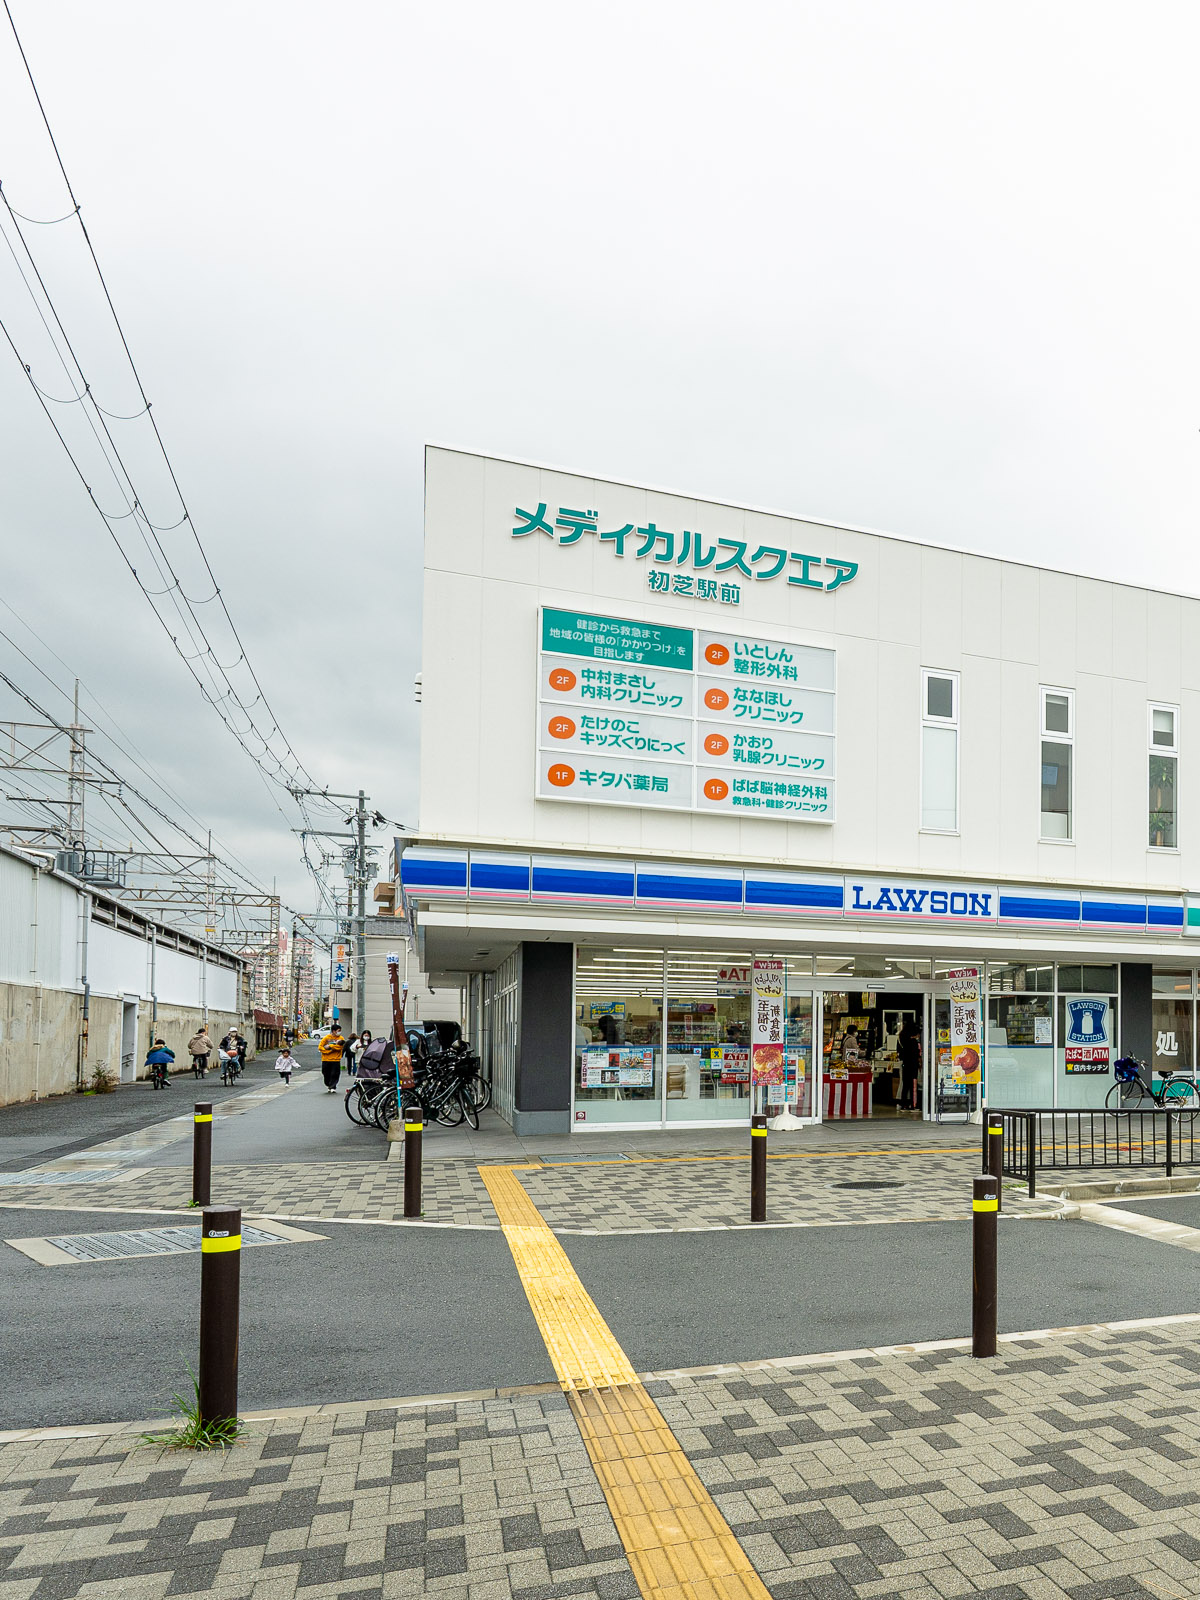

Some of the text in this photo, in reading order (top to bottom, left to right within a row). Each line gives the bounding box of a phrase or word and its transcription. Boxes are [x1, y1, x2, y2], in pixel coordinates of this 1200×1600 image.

[512, 502, 859, 592] メディカルスクエア
[648, 569, 742, 604] 初芝駅前
[576, 618, 661, 638] 健診から救急まで
[549, 628, 686, 656] 地域の皆様の「かかりつけ」を
[594, 646, 644, 662] 目指します
[710, 650, 724, 659] 2F
[734, 641, 793, 663] いとしん
[581, 668, 656, 690] 中村まさし
[734, 659, 798, 681] 整形外科
[556, 675, 570, 685] 2F
[581, 685, 683, 708] 内科クリニック
[710, 695, 723, 704] 2F
[733, 687, 792, 707] ななほし
[733, 704, 804, 724] クリニック
[555, 723, 569, 733] 2F
[580, 715, 640, 734] たけのこ
[580, 731, 686, 755] キッズくりにっく
[710, 740, 723, 749] 2F
[733, 734, 773, 750] かおり
[732, 748, 825, 770] 乳腺クリニック
[555, 771, 568, 780] 1F
[579, 769, 669, 792] キタバ薬局
[710, 785, 722, 794] 1F
[732, 778, 828, 800] ばば脳神経外科
[732, 795, 828, 813] 救急科・健診クリニック
[852, 885, 992, 916] LAWSON
[335, 964, 346, 982] 大地
[727, 968, 751, 981] AT
[1071, 1002, 1104, 1012] LAWSON
[1071, 1032, 1103, 1042] STATION
[1066, 1049, 1082, 1060] たばこ
[1093, 1050, 1109, 1059] ATM
[1074, 1064, 1108, 1072] 店内キッチン
